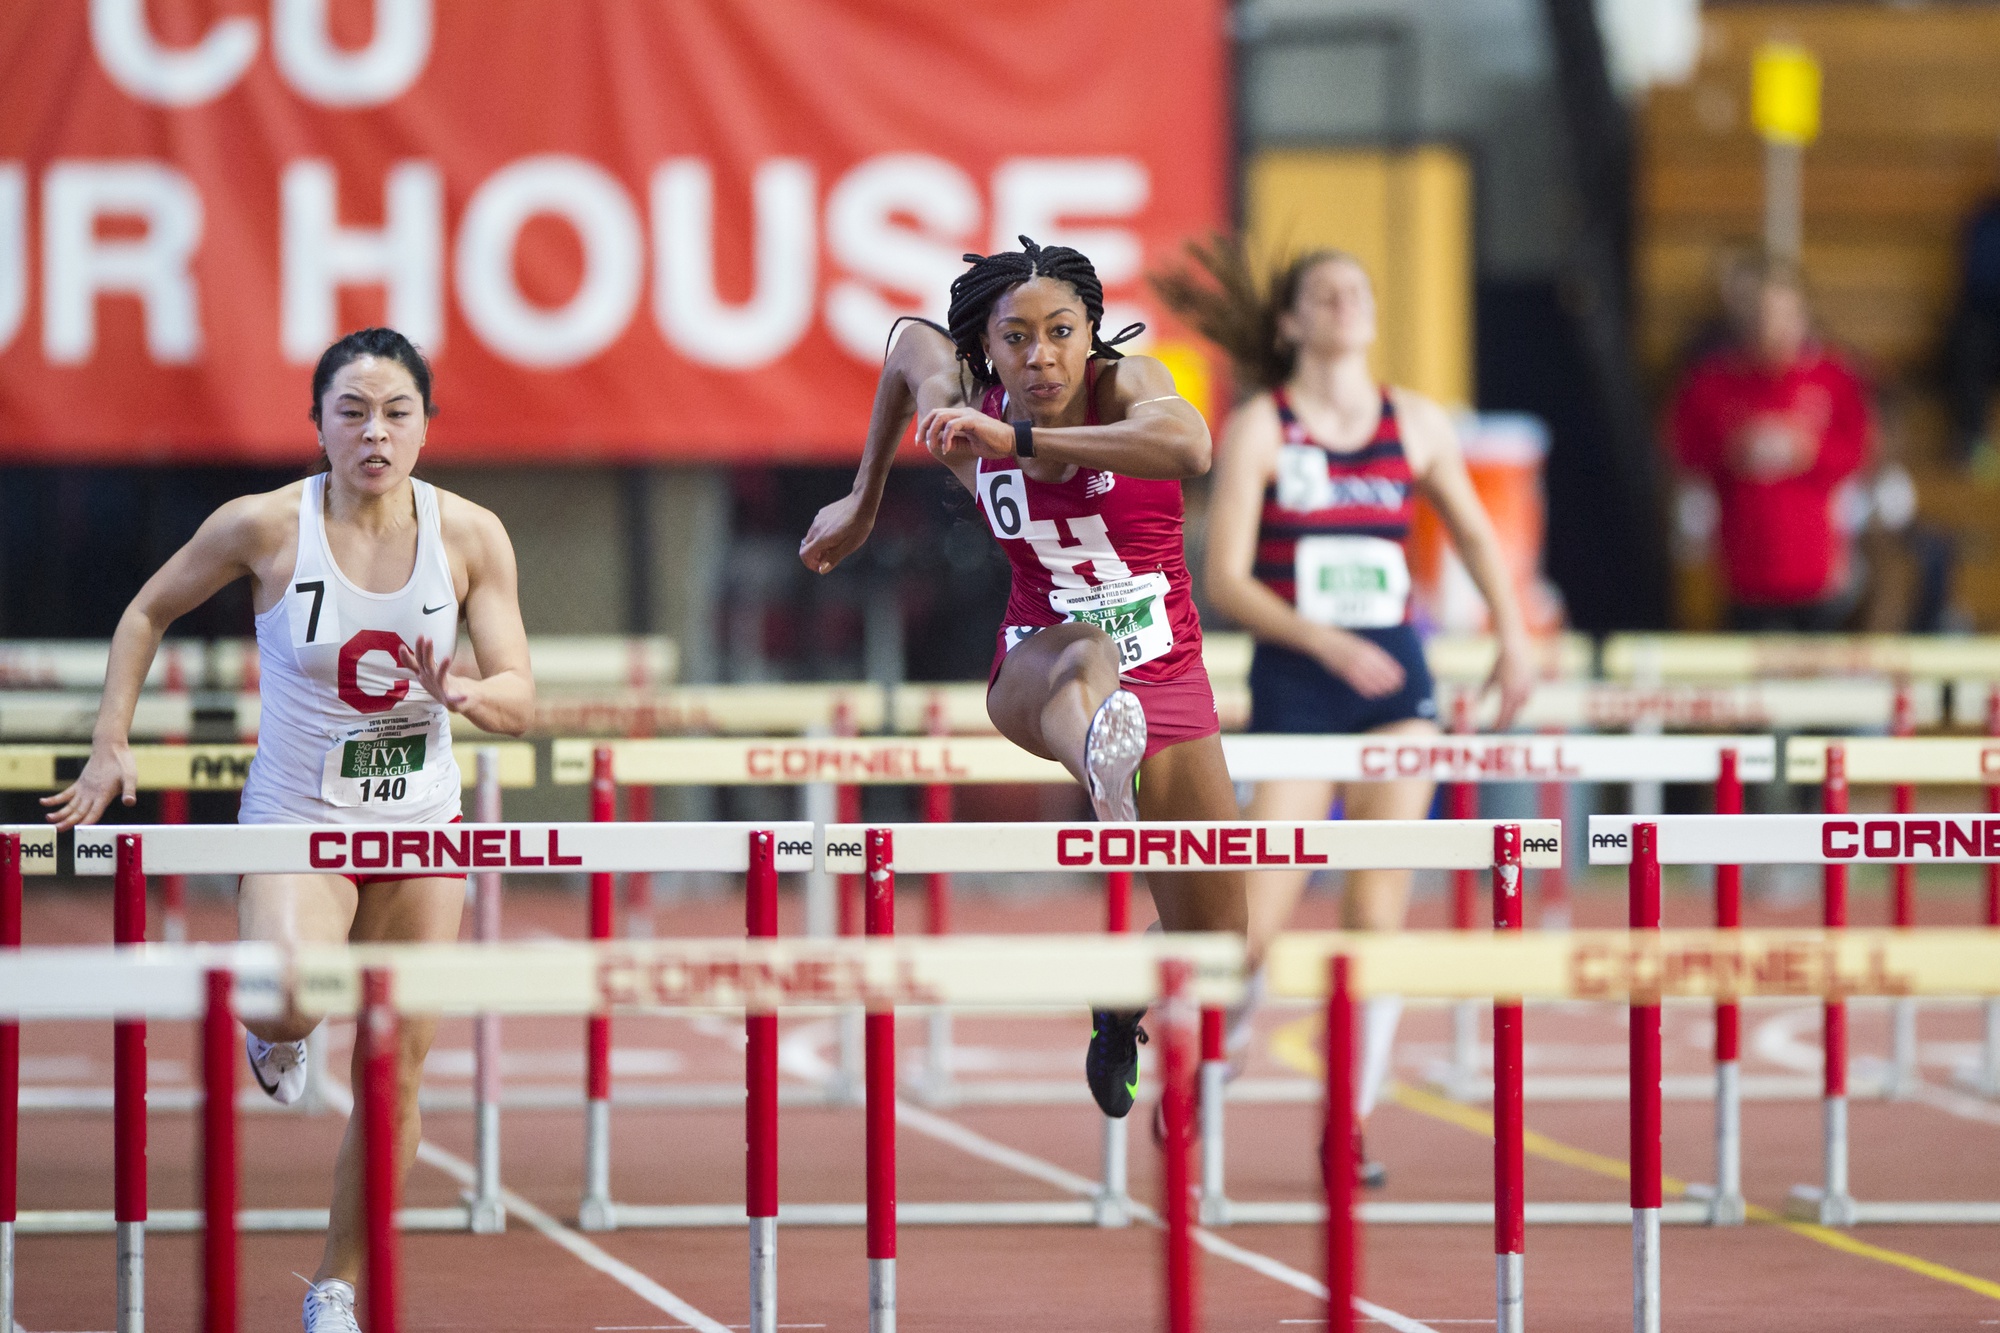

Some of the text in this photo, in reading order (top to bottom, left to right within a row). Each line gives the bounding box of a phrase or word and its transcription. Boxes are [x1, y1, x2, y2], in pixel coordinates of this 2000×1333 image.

[989, 474, 1022, 536] 6
[1024, 513, 1133, 589] H
[1085, 593, 1101, 602] TRACK
[1106, 590, 1119, 598] FIELD
[1102, 580, 1134, 590] HEPTAGONAL
[295, 580, 325, 643] 7
[1099, 608, 1117, 618] THE
[1099, 607, 1141, 631] IVY
[338, 629, 415, 714] C
[369, 744, 412, 767] IVY
[373, 740, 389, 748] THE
[368, 764, 410, 776] LEAGUE
[745, 747, 969, 778] CORNELL
[1361, 747, 1581, 777] CORNELL
[360, 777, 407, 802] 140
[310, 830, 582, 868] CORNELL
[1057, 828, 1328, 865] CORNELL
